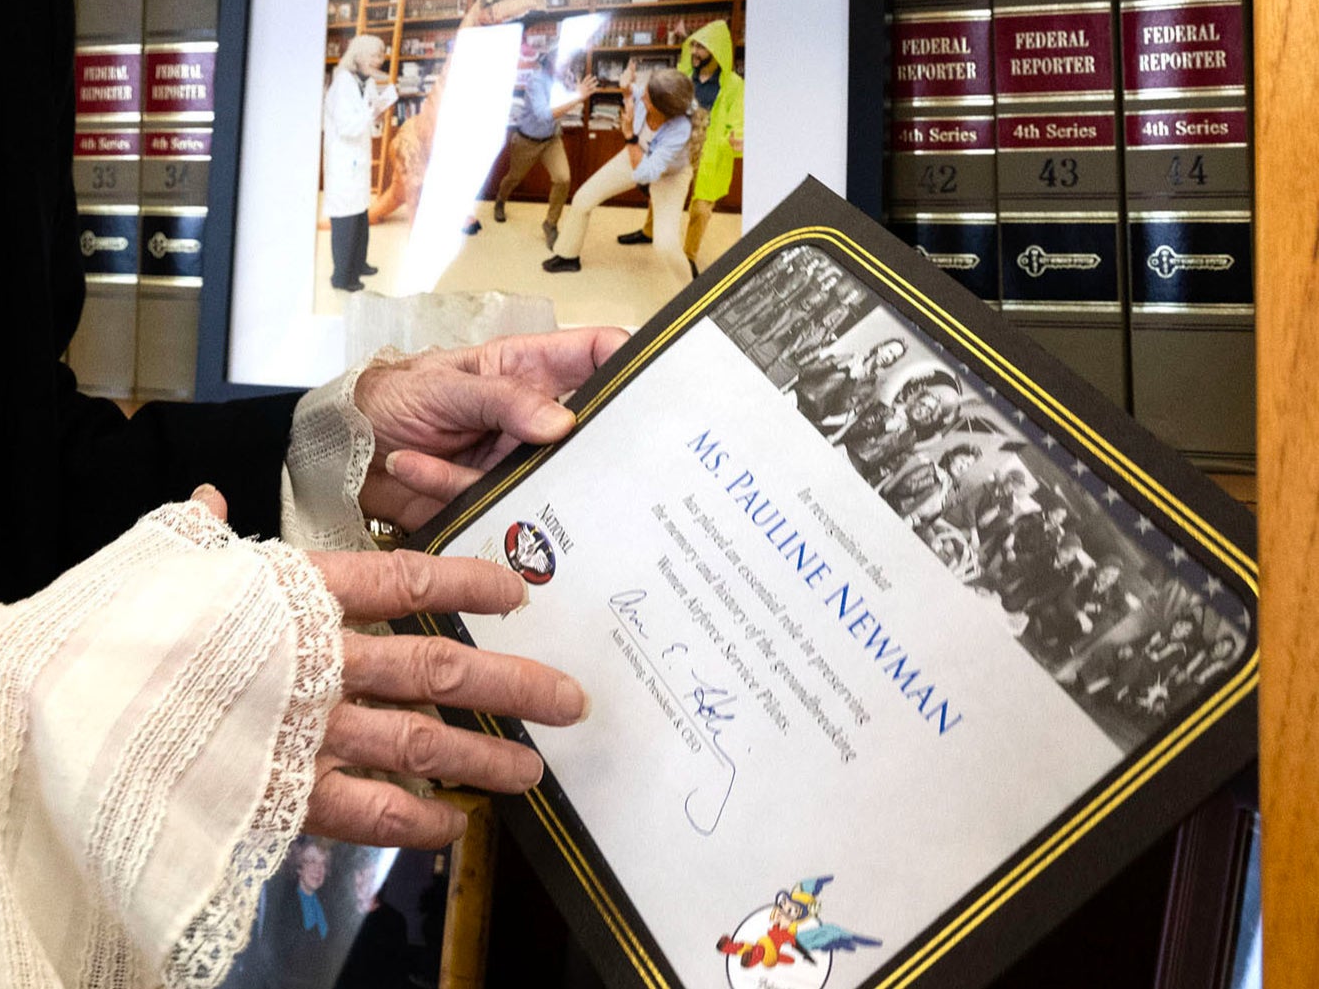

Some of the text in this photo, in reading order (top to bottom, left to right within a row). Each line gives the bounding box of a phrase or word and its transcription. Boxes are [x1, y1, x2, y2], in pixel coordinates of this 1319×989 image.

[1014, 30, 1089, 50] FEDERAL
[1142, 23, 1221, 46] FEDERAL
[901, 36, 971, 56] FEDERAL
[897, 62, 977, 82] REPORTER
[1010, 55, 1096, 77] REPORTER
[1139, 50, 1227, 72] REPORTER
[928, 126, 977, 143] Series
[1012, 122, 1097, 141] 4th Series
[1141, 118, 1229, 137] 4th Series
[918, 165, 958, 194] 42
[1038, 157, 1080, 188] 43
[1167, 155, 1209, 186] 44
[796, 486, 893, 593] In recognition that
[681, 492, 702, 517] has
[692, 512, 734, 552] played
[737, 564, 788, 618] essential
[777, 613, 804, 642] role
[806, 653, 872, 728] preserving
[650, 502, 669, 523] the
[663, 518, 701, 564] memory
[694, 560, 722, 586] and
[711, 579, 750, 626] history
[755, 636, 778, 661] the
[768, 659, 858, 765] groundbreaking
[656, 553, 791, 737] Women Airforce Service Pilots.
